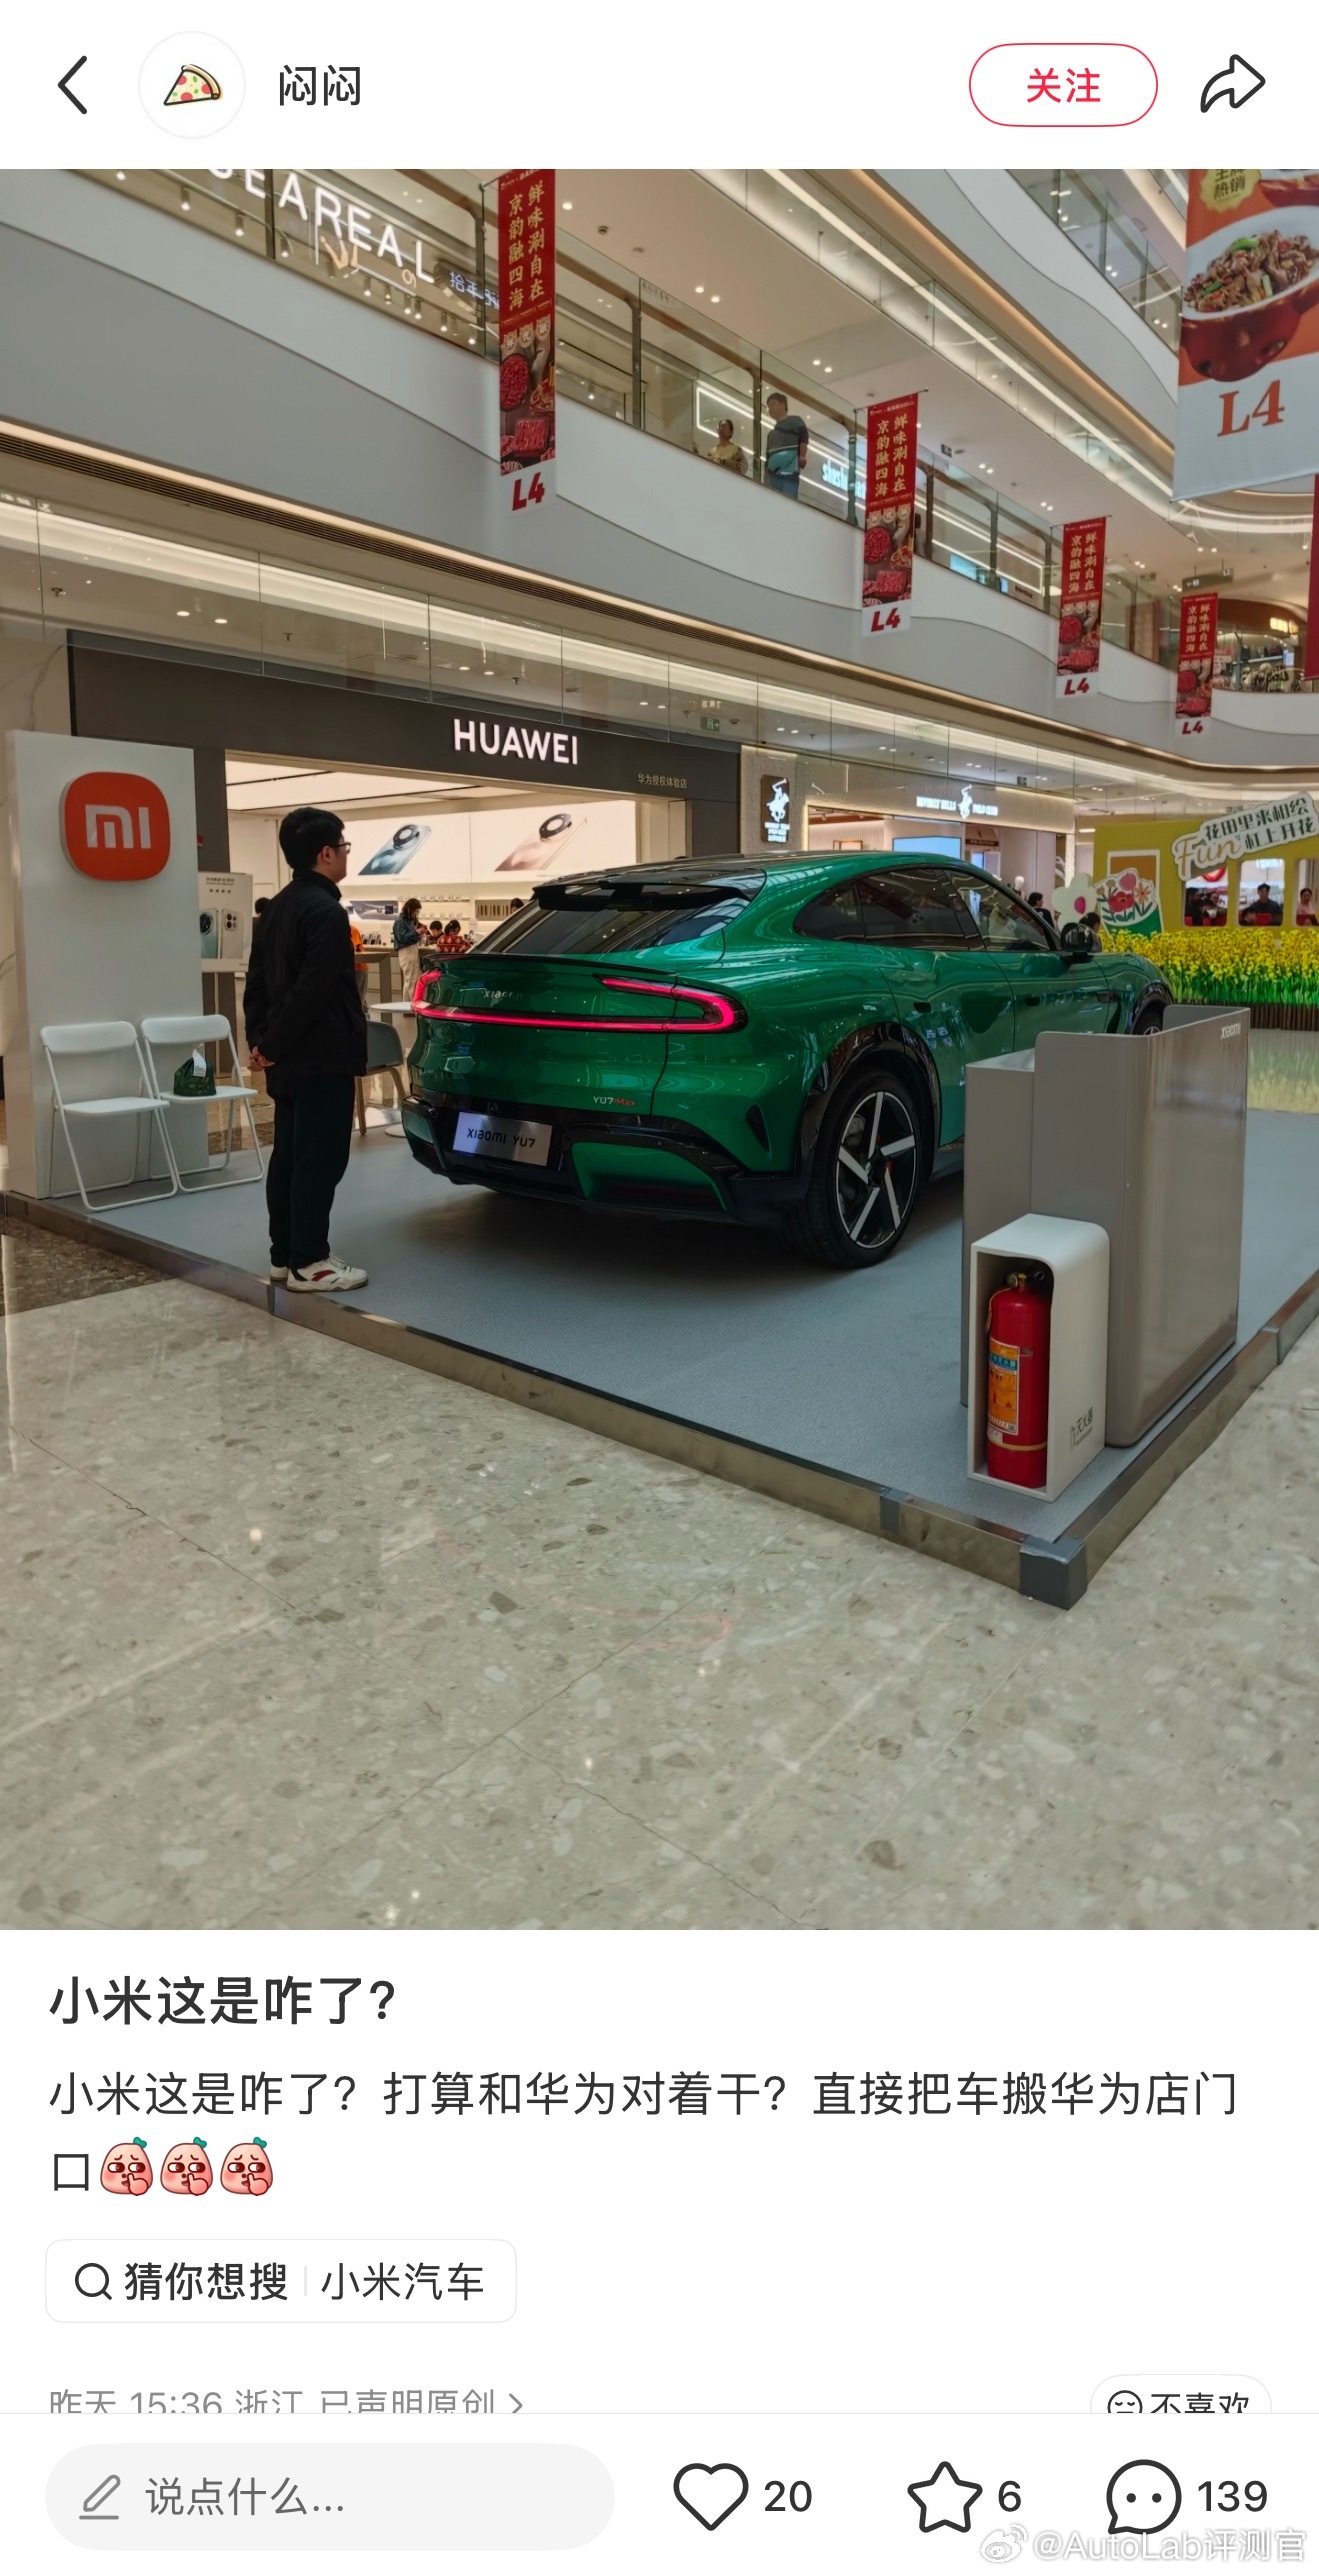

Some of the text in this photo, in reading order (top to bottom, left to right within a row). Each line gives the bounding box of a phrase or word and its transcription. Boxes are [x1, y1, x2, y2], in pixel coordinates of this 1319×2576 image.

[207, 169, 436, 284] EAREAL
[527, 179, 545, 302] 鲜味涮自在
[508, 194, 524, 312] 京韵融四海
[1217, 379, 1285, 437] L4
[875, 419, 890, 498] 京韵融四海
[892, 413, 908, 494] 鲜味涮自在
[512, 471, 545, 511] L4
[870, 607, 901, 632] L4
[1064, 677, 1090, 695] L4
[454, 718, 578, 765] HUAWEI
[1181, 720, 1204, 735] L4
[637, 772, 688, 789] 华为授权体验店
[1245, 816, 1317, 850] 杠上开花
[1174, 836, 1236, 877] Fun
[593, 1096, 636, 1106] YU7 Max
[513, 1136, 536, 1149] YU7
